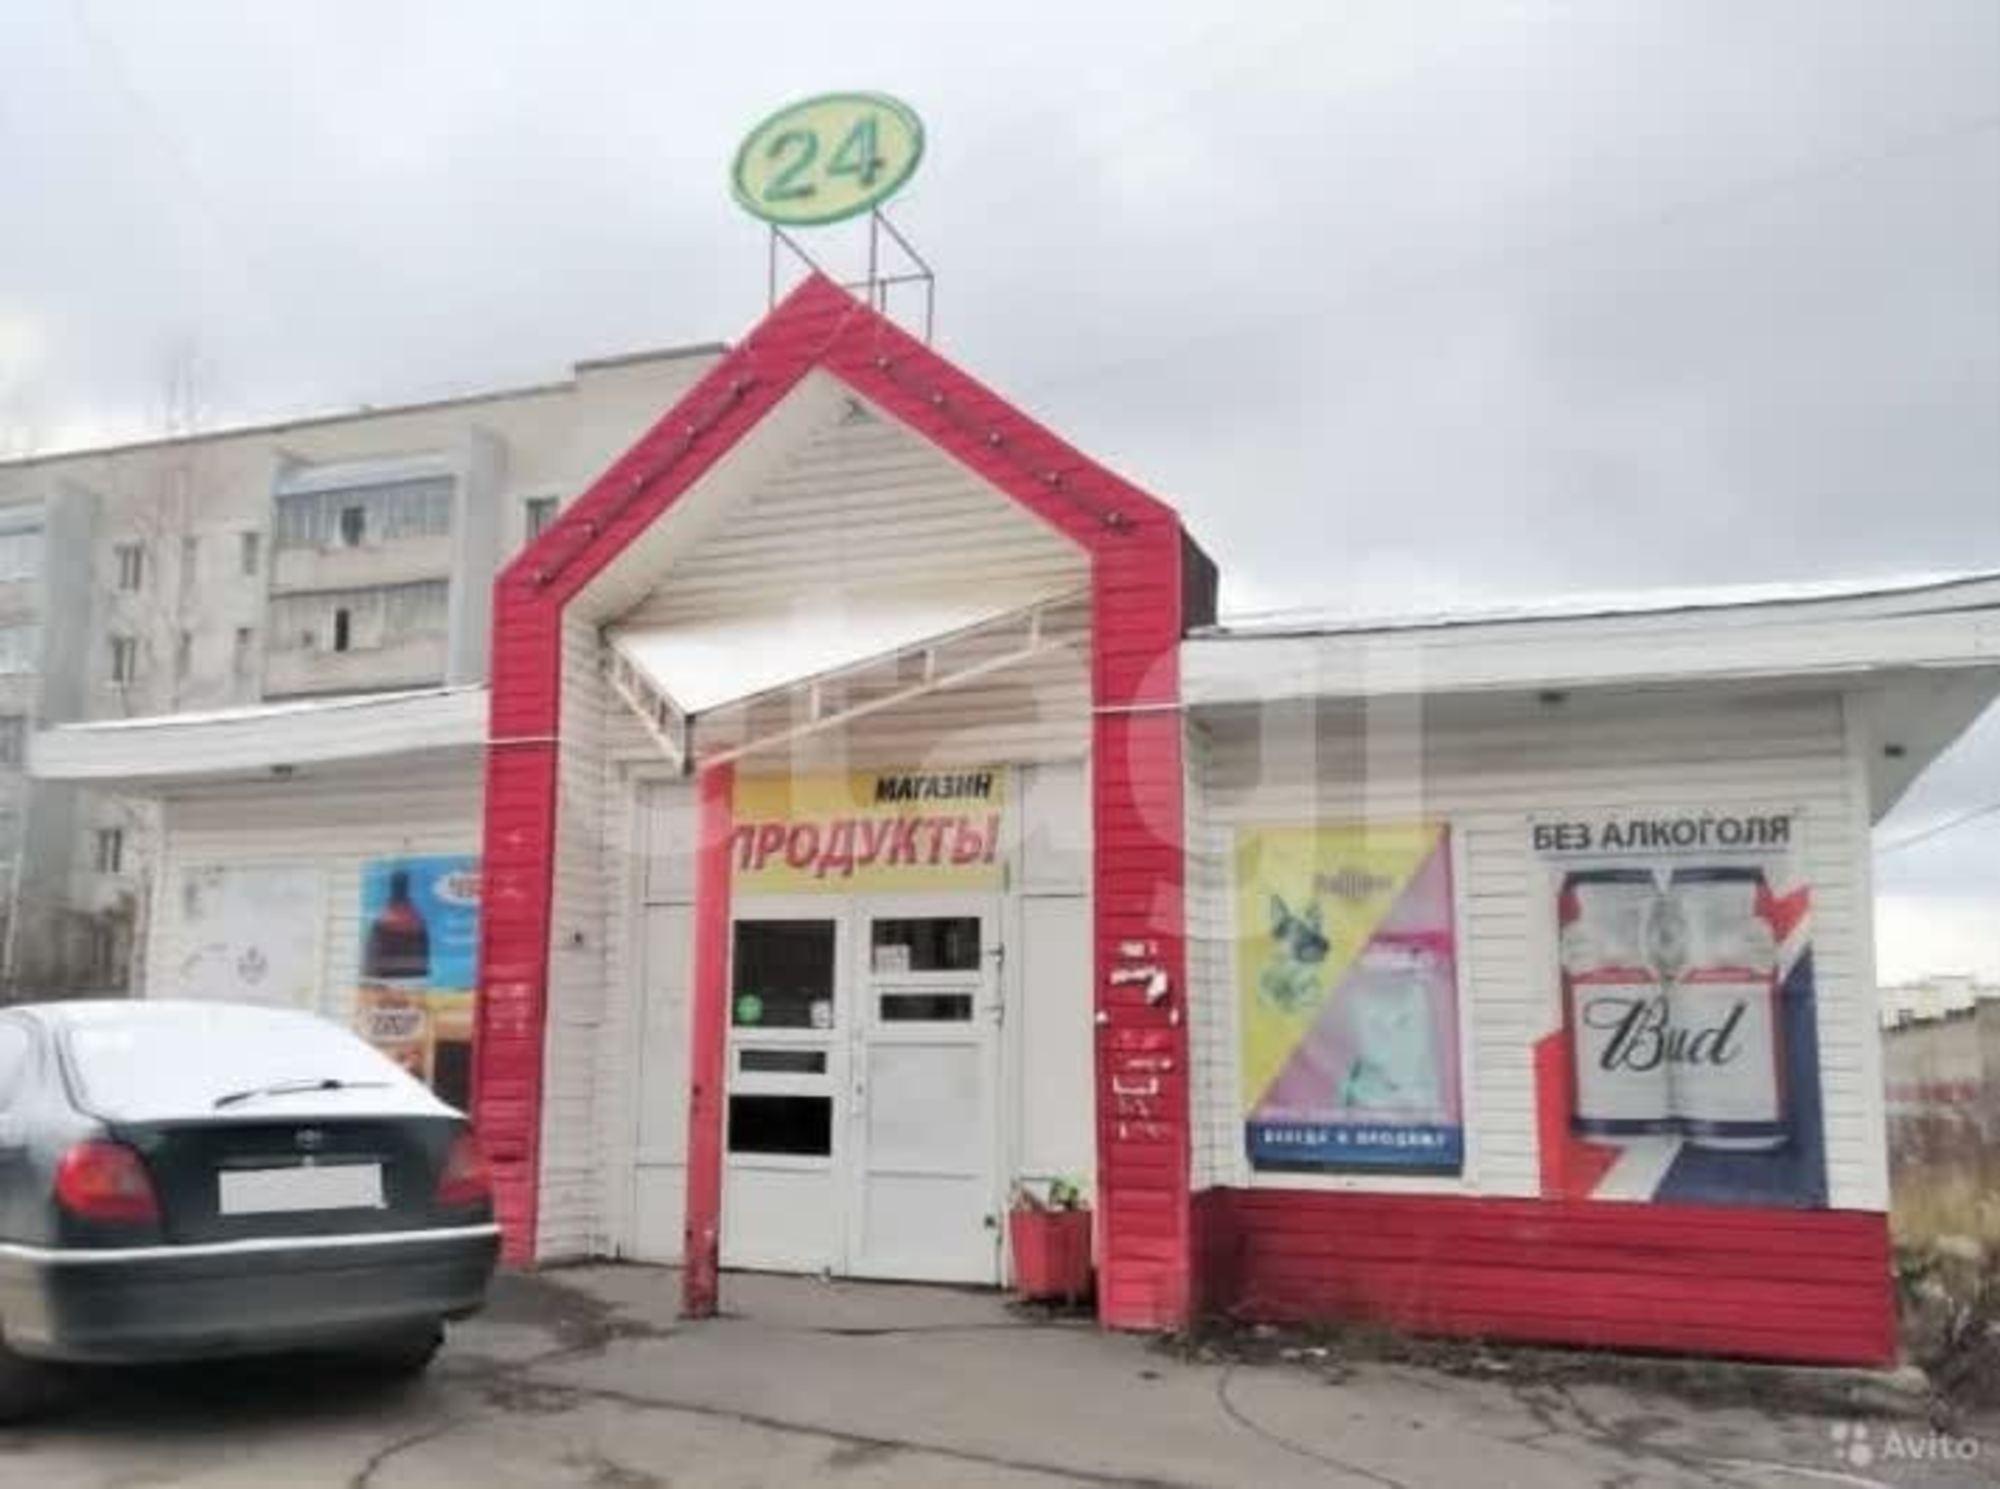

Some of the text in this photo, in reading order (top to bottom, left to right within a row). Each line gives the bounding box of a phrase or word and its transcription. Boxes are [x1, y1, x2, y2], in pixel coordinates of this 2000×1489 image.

[762, 114, 886, 202] 24
[875, 772, 993, 802] МАГАЗИН
[730, 812, 999, 878] ПРОДУКТЫ
[1533, 814, 1791, 851] БЕЗ АЛКОГОЛЯ
[1582, 996, 1749, 1072] Bud
